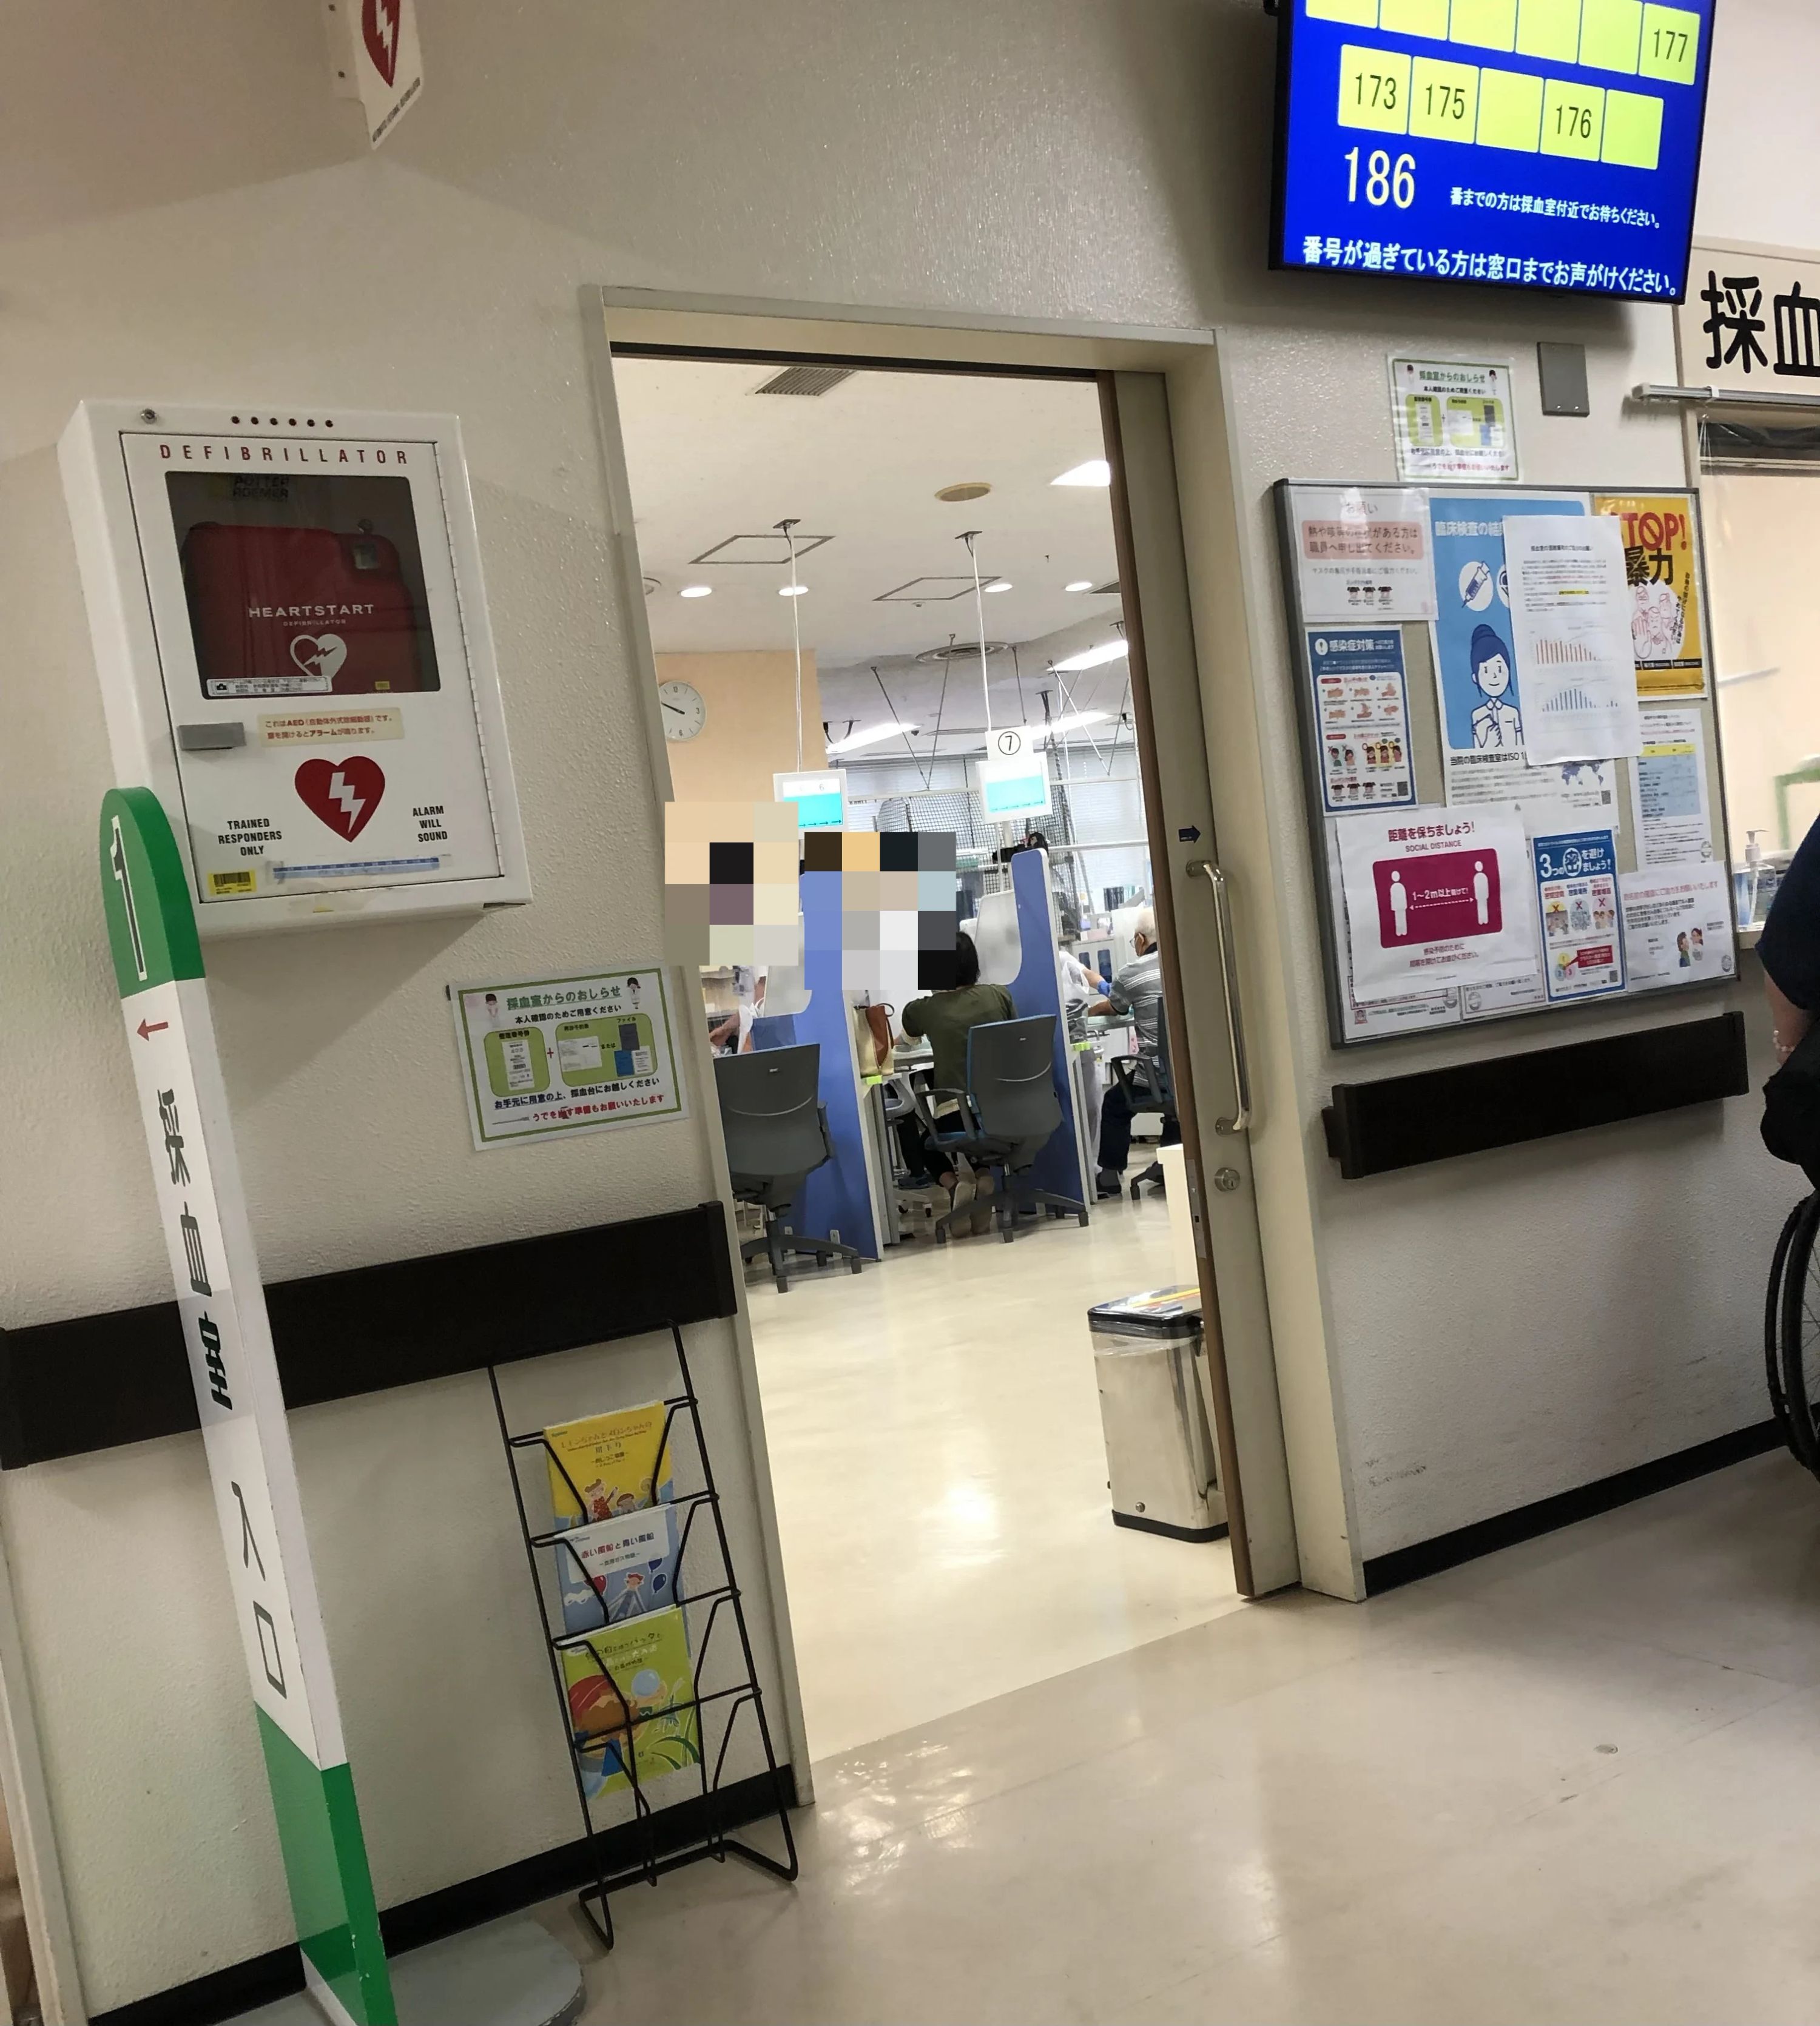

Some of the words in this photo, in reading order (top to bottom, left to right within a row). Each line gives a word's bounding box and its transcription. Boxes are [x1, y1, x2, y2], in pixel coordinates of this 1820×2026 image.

[1653, 28, 1688, 64] 177
[1354, 73, 1397, 110] 173
[1426, 86, 1465, 119] 175
[1555, 107, 1591, 140] 176
[1345, 147, 1415, 208] 186
[1449, 187, 1660, 229] 番までの方は採血室付近でお待ちください。
[1303, 235, 1677, 296] 番号が過ぎている方は窓口までお声がけください。
[1700, 270, 1820, 377] 採血
[160, 444, 408, 465] DEFIBRILLATOR
[1609, 511, 1687, 551] TOP!
[248, 604, 375, 618] HEARTSTART
[413, 804, 445, 818] ALARM
[227, 818, 271, 830] TRAINED
[419, 817, 443, 830] WILL
[218, 830, 283, 844] RESPONDERS
[417, 830, 448, 843] SOUND
[1405, 843, 1429, 853] SOCIAL
[1430, 840, 1462, 850] DISTANCE
[240, 845, 265, 857] ONLY
[110, 815, 148, 982] 1
[506, 986, 622, 1011] 採血室からのおしらせ
[514, 1004, 622, 1025] 本人確認のためご用意ください
